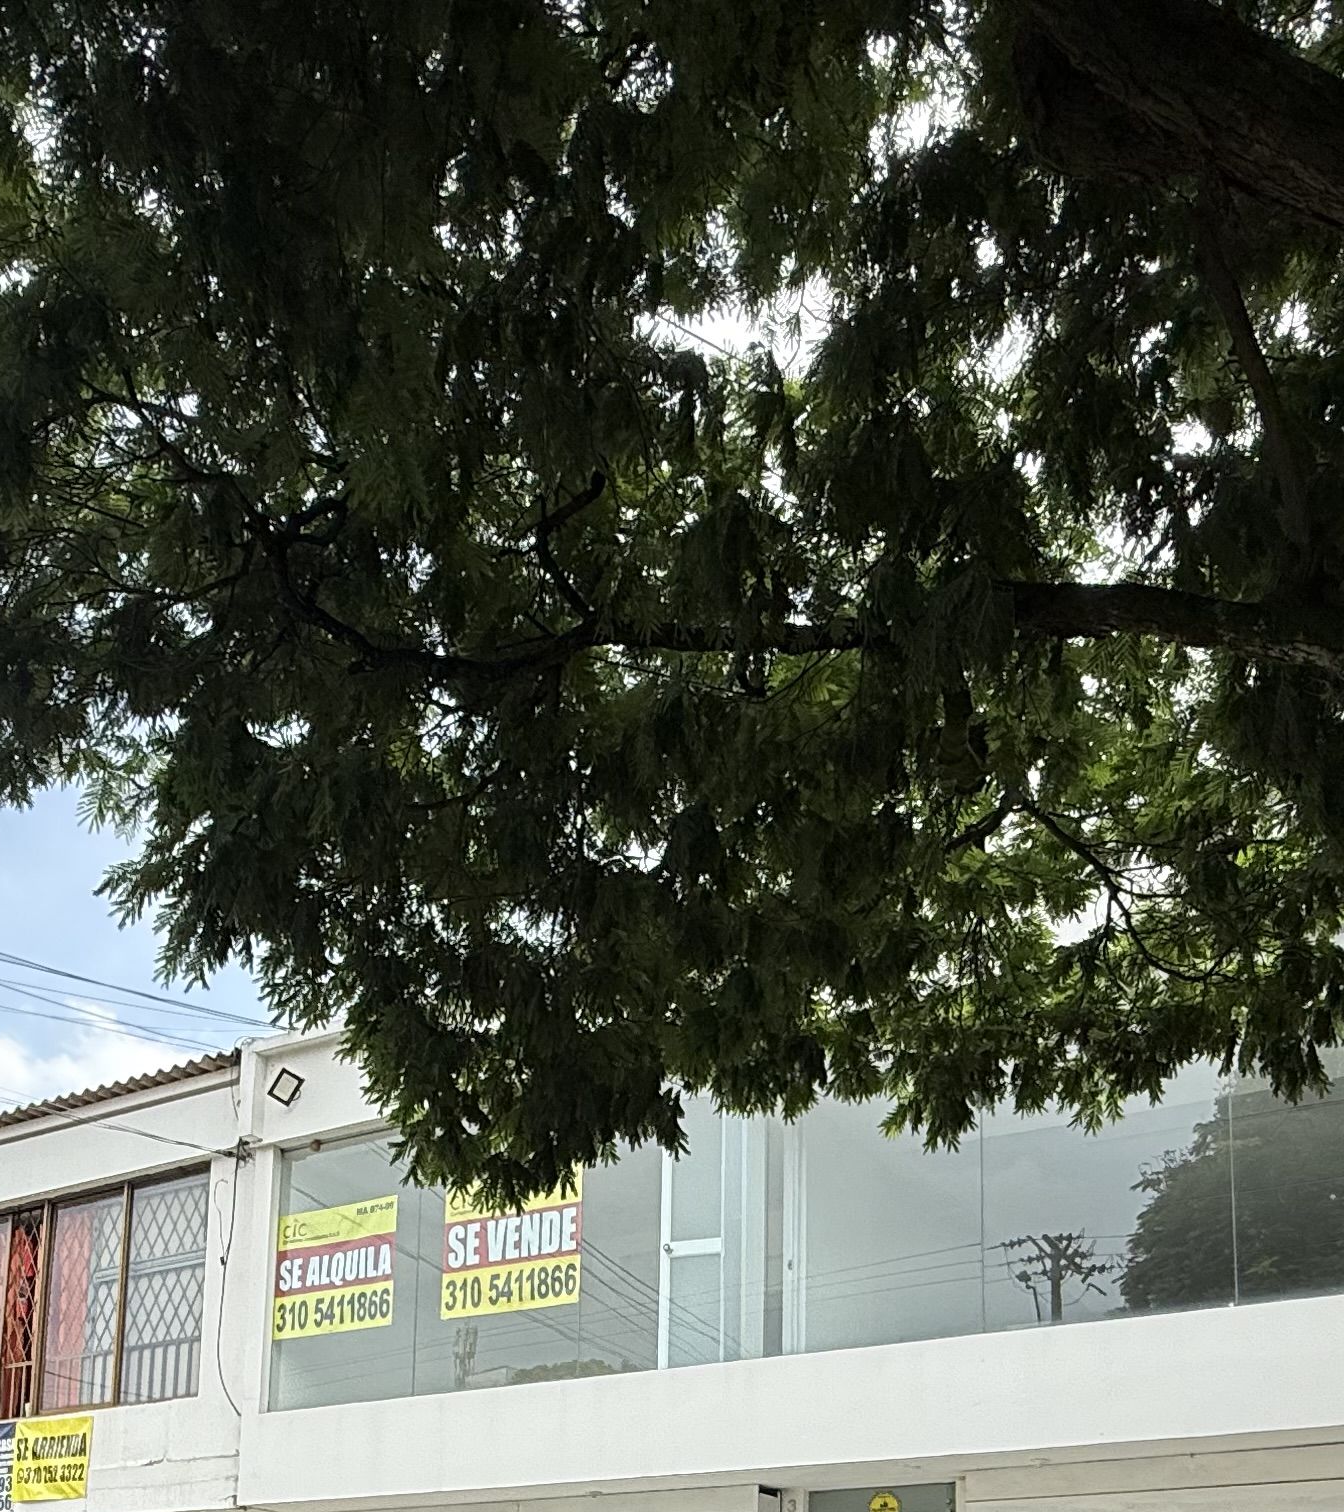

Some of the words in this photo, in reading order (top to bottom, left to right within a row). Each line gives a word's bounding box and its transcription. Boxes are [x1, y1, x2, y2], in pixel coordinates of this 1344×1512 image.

[448, 1222, 480, 1268] SE
[487, 1207, 577, 1262] VENDE
[279, 1258, 304, 1292] SE
[306, 1244, 392, 1286] ALQUILA
[445, 1275, 482, 1311] 310
[488, 1263, 578, 1306] 5411866
[276, 1300, 309, 1333] 310
[314, 1288, 391, 1328] 5411866
[16, 1437, 28, 1462] SE
[32, 1432, 87, 1461] ARRIENDA
[60, 1463, 85, 1482] 3322
